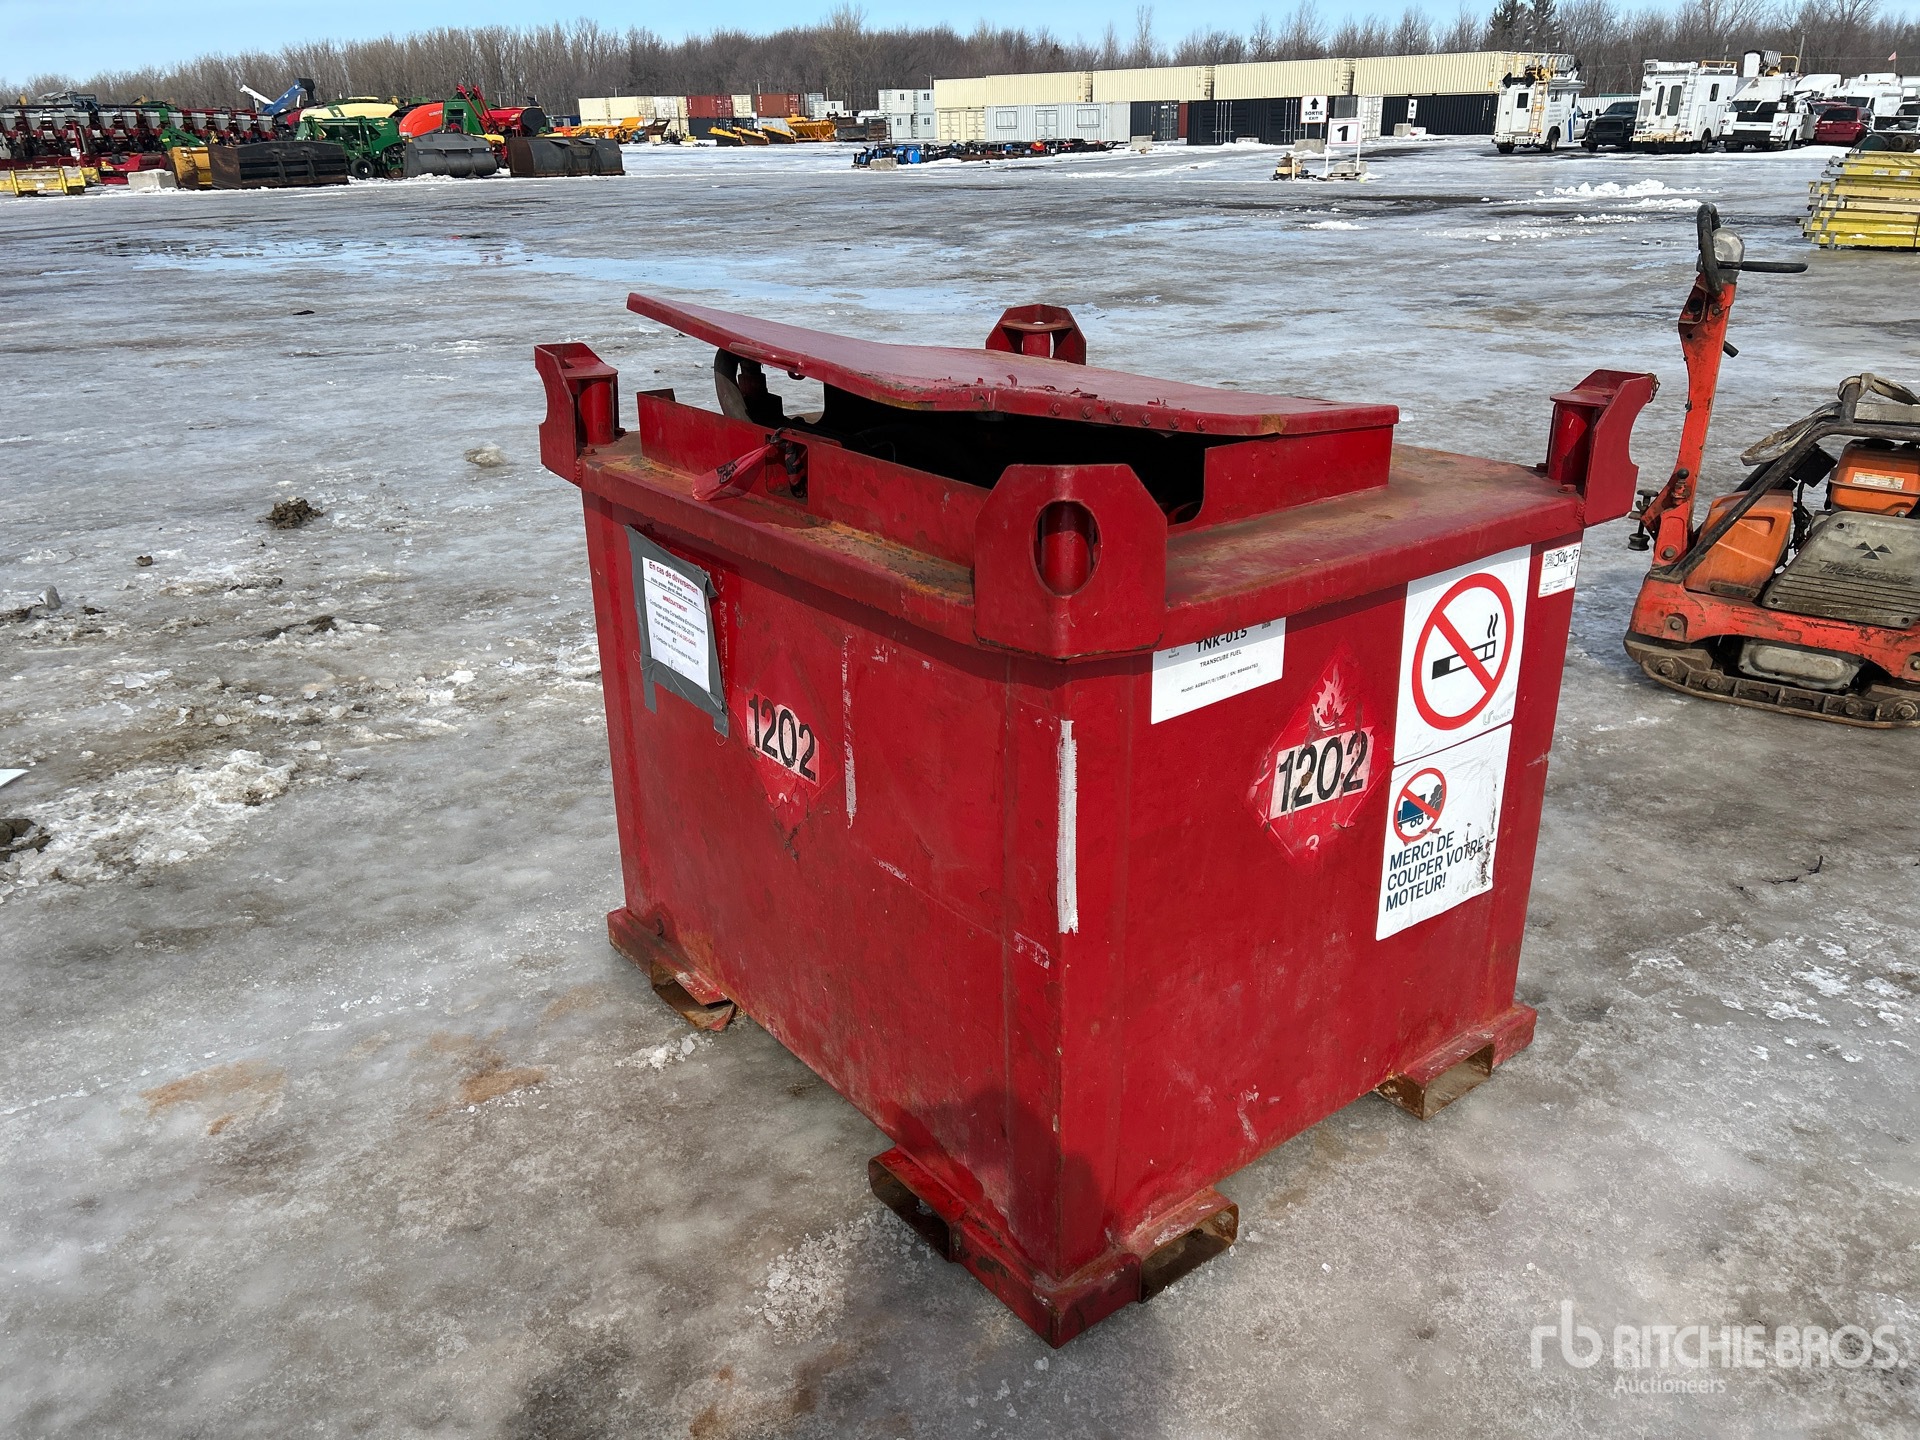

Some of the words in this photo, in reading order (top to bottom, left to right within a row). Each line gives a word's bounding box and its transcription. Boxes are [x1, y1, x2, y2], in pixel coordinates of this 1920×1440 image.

[1336, 125, 1349, 142] 1
[1196, 629, 1248, 653] TNK-015
[1199, 653, 1230, 668] TRANSCUBE
[1229, 649, 1242, 657] FUEL
[749, 694, 816, 782] 1202
[1278, 730, 1368, 813] 1202
[1387, 855, 1444, 891] COUPER
[1446, 835, 1485, 867] VOTRE
[1389, 841, 1434, 872] MERCI
[1436, 830, 1455, 852] DE
[1385, 872, 1447, 912] MOTEUR!
